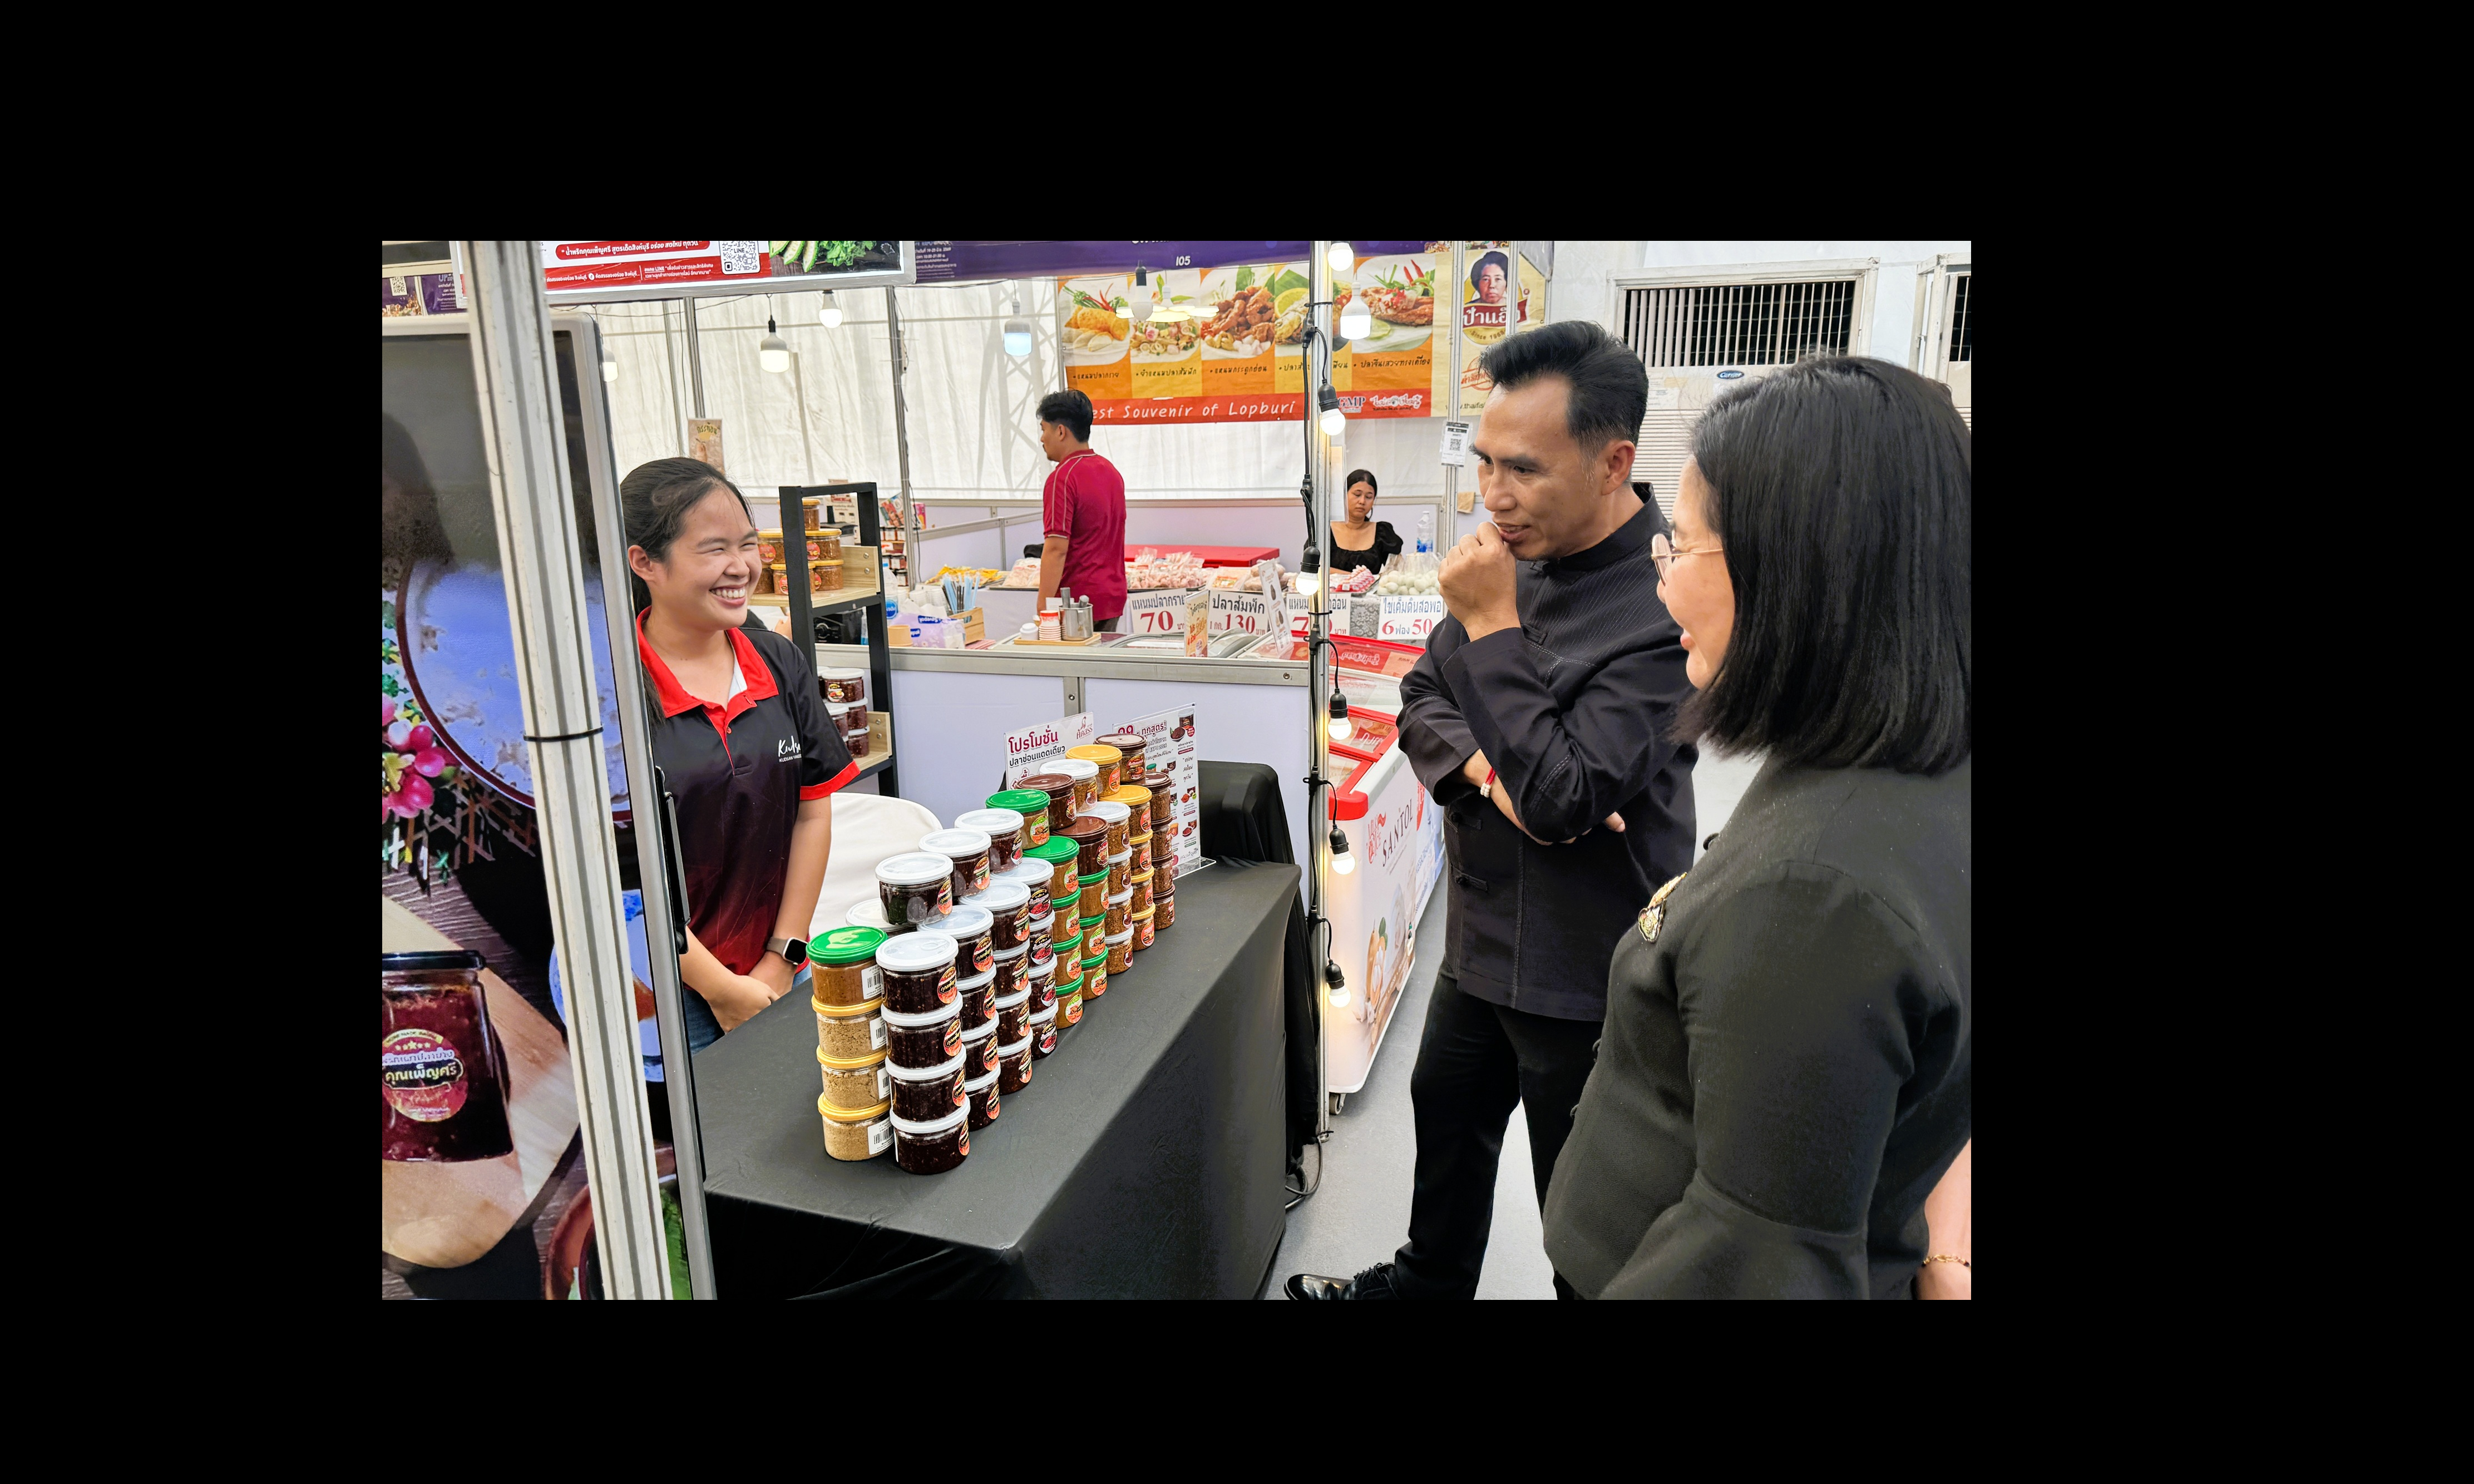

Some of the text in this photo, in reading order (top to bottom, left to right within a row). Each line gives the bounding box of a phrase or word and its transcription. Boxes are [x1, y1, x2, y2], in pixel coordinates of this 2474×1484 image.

[1176, 256, 1191, 266] 105
[1719, 371, 1743, 379] Carrier
[1092, 401, 1296, 419] est Souvenir of Lopburi
[1338, 397, 1366, 407] GMP
[1212, 594, 1265, 615] ปลาส้มฟัก
[1140, 610, 1174, 633] 70
[1225, 614, 1255, 634] 130
[1382, 618, 1433, 635] 6 ฟอง 50
[1008, 725, 1058, 754] โปรโมชั่น
[1009, 745, 1065, 766] ปลาช่อนแดดเดียว
[1382, 798, 1413, 867] SANTOL
[385, 1061, 457, 1085] คุณเพ็ญศรี
